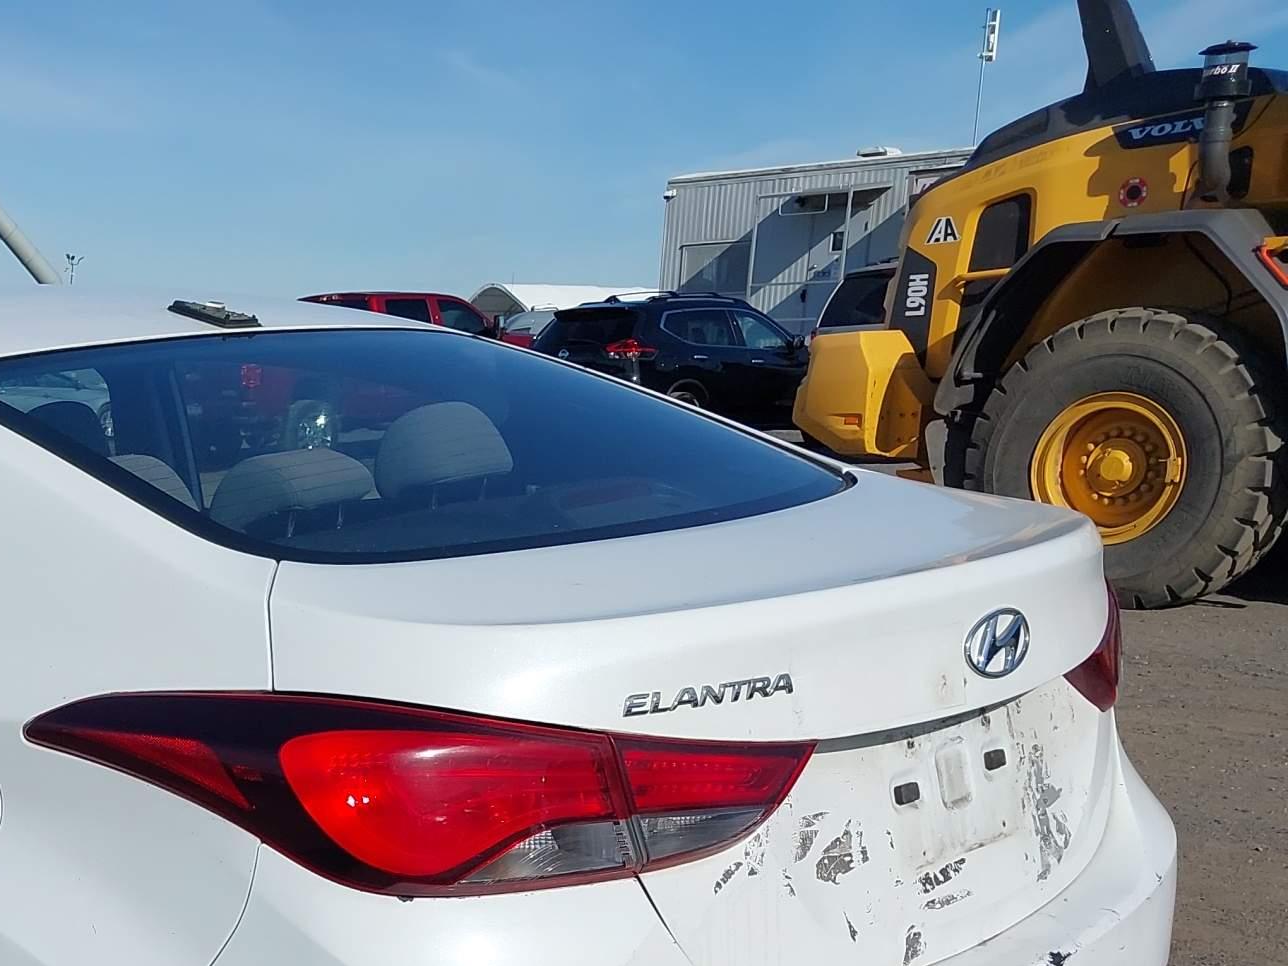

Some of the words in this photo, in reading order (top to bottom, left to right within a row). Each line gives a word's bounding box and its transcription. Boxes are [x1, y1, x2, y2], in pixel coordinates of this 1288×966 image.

[1128, 116, 1207, 141] VOLV
[904, 273, 930, 317] L90H
[622, 673, 794, 717] ELANTRA
